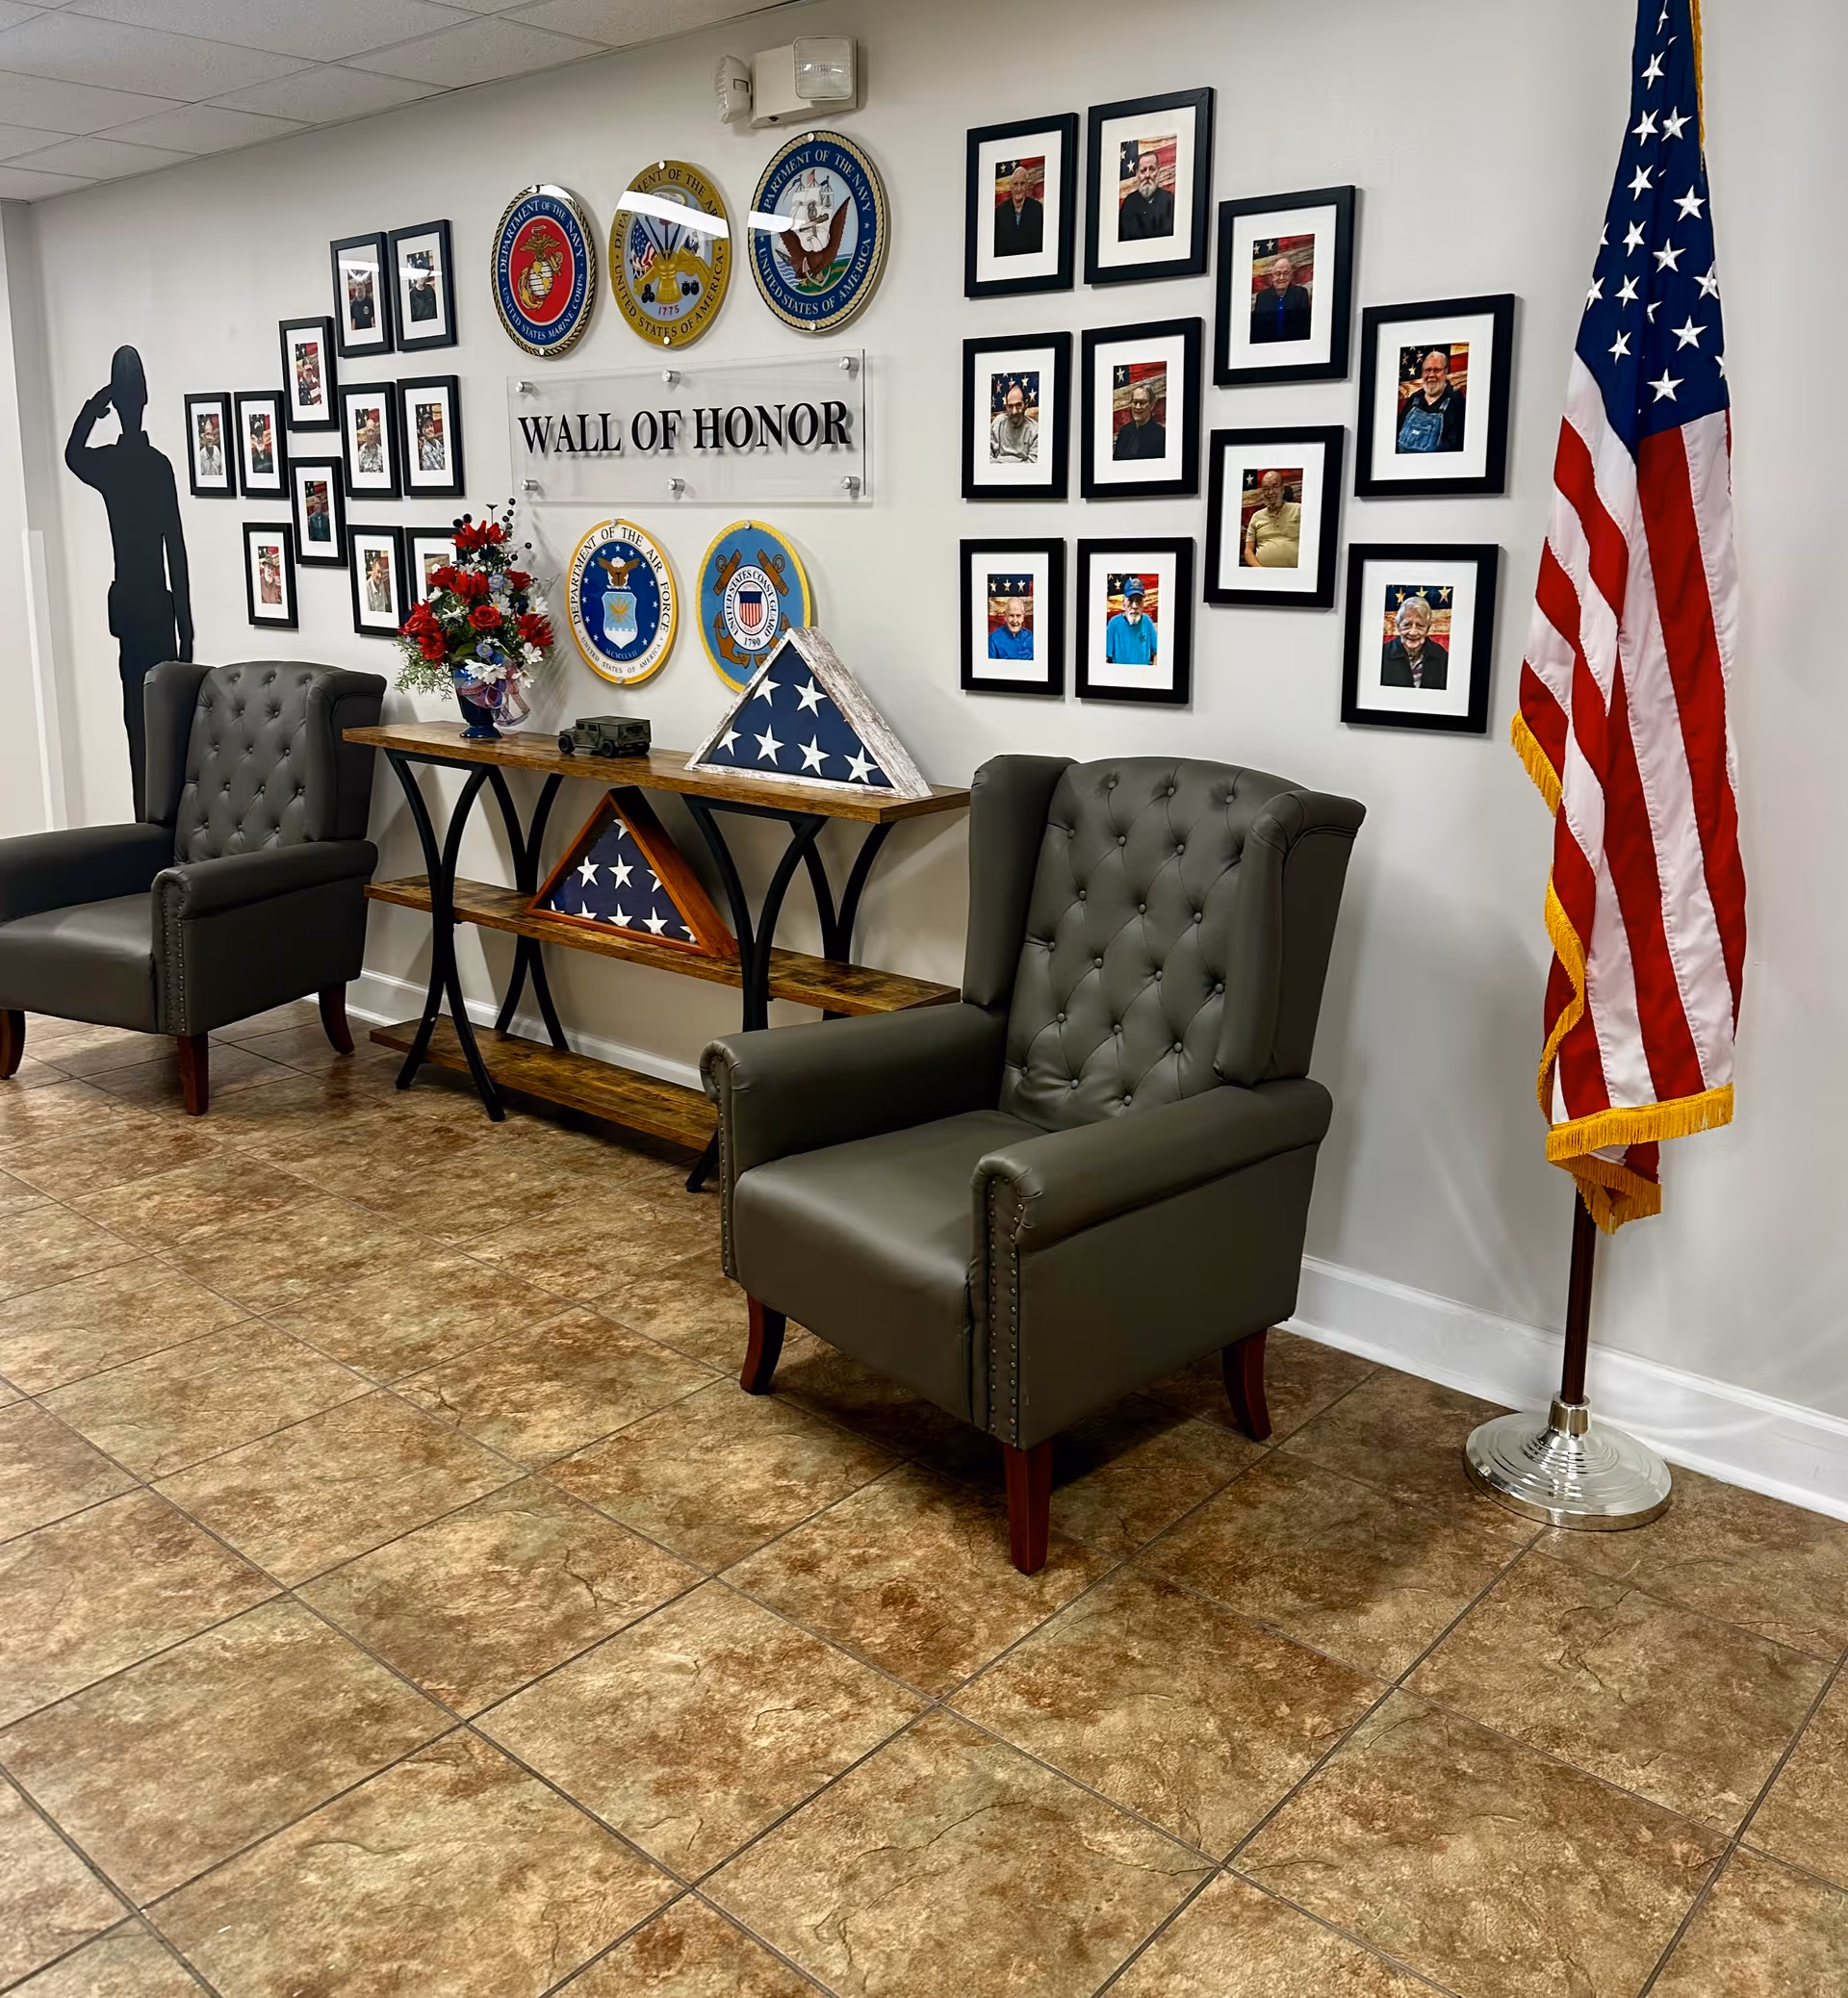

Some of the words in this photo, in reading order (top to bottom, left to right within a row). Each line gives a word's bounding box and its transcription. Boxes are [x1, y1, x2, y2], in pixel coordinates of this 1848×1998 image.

[668, 168, 681, 180] OF
[685, 174, 706, 196] THE
[762, 151, 810, 215] PARTMENT
[815, 149, 830, 162] OF
[834, 152, 855, 177] THE
[852, 175, 872, 213] NAVY
[500, 200, 540, 273] DEPARTMENT
[541, 200, 551, 211] OF
[552, 203, 566, 220] THE
[566, 219, 584, 260] NAVY
[614, 266, 637, 318] UNITED
[638, 317, 678, 338] STATES
[680, 320, 694, 334] OF
[695, 250, 725, 323] AMERICA
[758, 247, 783, 297] UNITED
[782, 295, 819, 315] STATES
[821, 296, 836, 312] OF
[839, 238, 871, 302] AMERICA
[502, 286, 521, 330] UNITED
[521, 323, 546, 340] STATES
[548, 310, 575, 339] MARINE
[573, 273, 584, 310] CORPS
[657, 305, 680, 316] 1775
[517, 412, 622, 454] WALL
[630, 409, 682, 451] OF
[692, 400, 852, 449] HONOR
[570, 535, 597, 626] DEPARTMENT
[601, 526, 615, 539] OF
[621, 526, 644, 547] THE
[645, 549, 664, 574] AIR
[660, 580, 671, 633] FORCE
[730, 570, 752, 594] STATES
[753, 571, 775, 598] COAST
[727, 595, 738, 635] UNITED
[765, 600, 776, 637] GUARD
[580, 636, 601, 662] UNITED
[602, 660, 623, 674] STATES
[627, 665, 636, 674] OF
[639, 643, 662, 670] AMERICA
[744, 637, 760, 647] 1790
